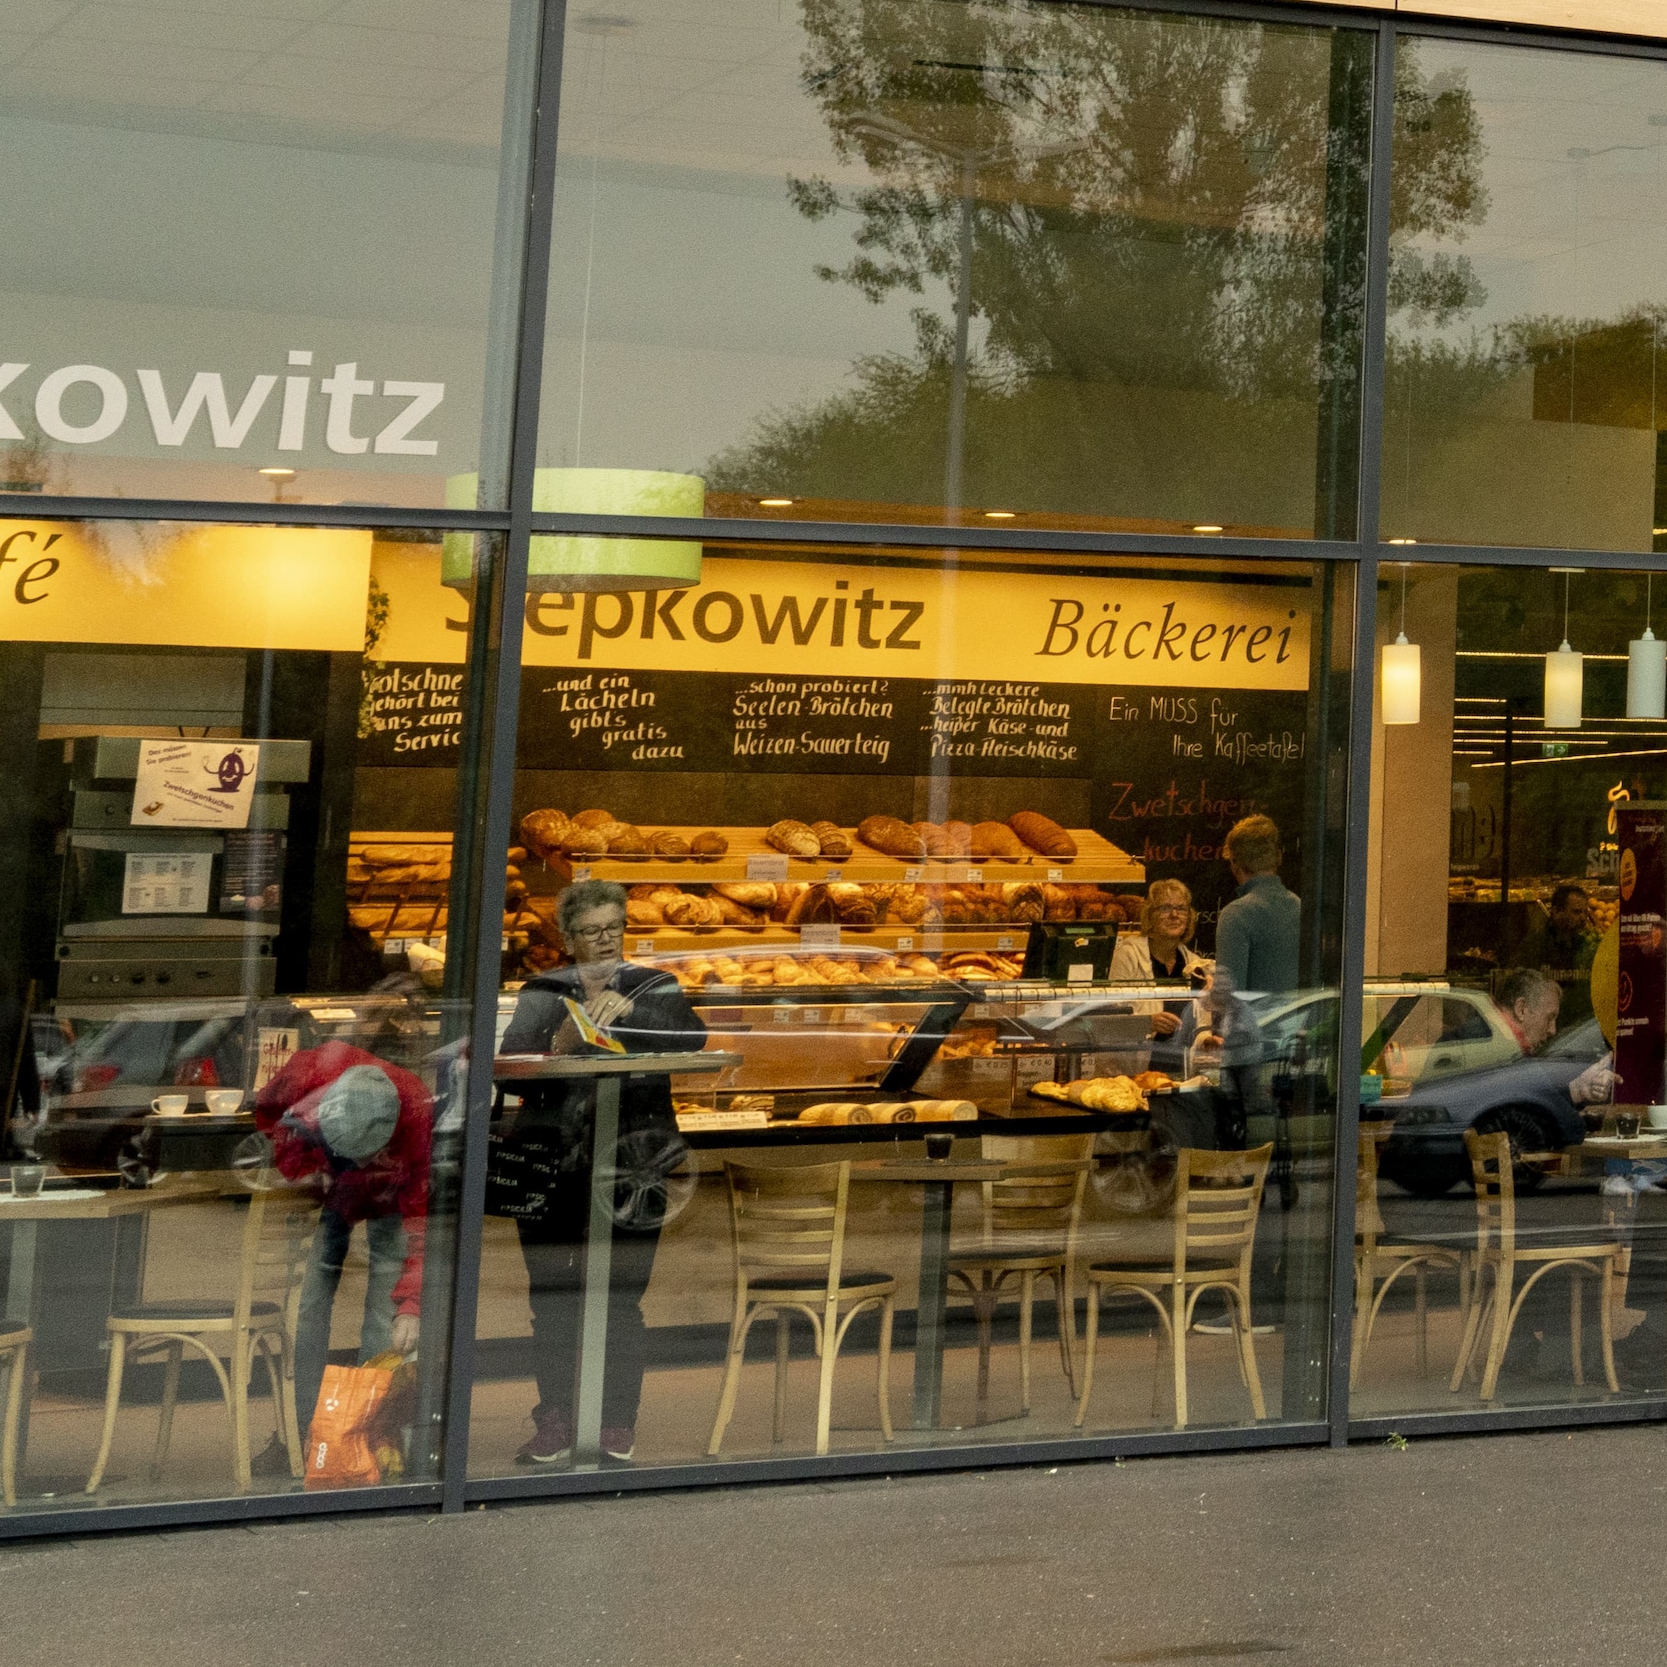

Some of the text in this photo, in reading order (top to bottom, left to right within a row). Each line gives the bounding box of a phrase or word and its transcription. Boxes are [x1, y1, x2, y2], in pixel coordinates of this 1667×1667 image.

[446, 581, 925, 660] epkowitz
[1035, 598, 1297, 664] Bäckerei
[599, 673, 631, 690] ein
[800, 679, 889, 700] probiert?
[430, 691, 460, 708] bei
[560, 688, 656, 712] Lächeln
[929, 696, 1073, 720] Belegte Brötchen
[416, 712, 463, 727] zum
[735, 718, 769, 730] aus
[1109, 696, 1238, 735] Ein MUSS für
[393, 729, 461, 752] Servic
[602, 722, 668, 750] gratis
[733, 731, 891, 764] Weizen-Sauerteig
[631, 744, 685, 760] dazu
[1173, 731, 1305, 766] Ihre Kaffeetafel
[163, 780, 234, 811] Zwetschgenkuchen
